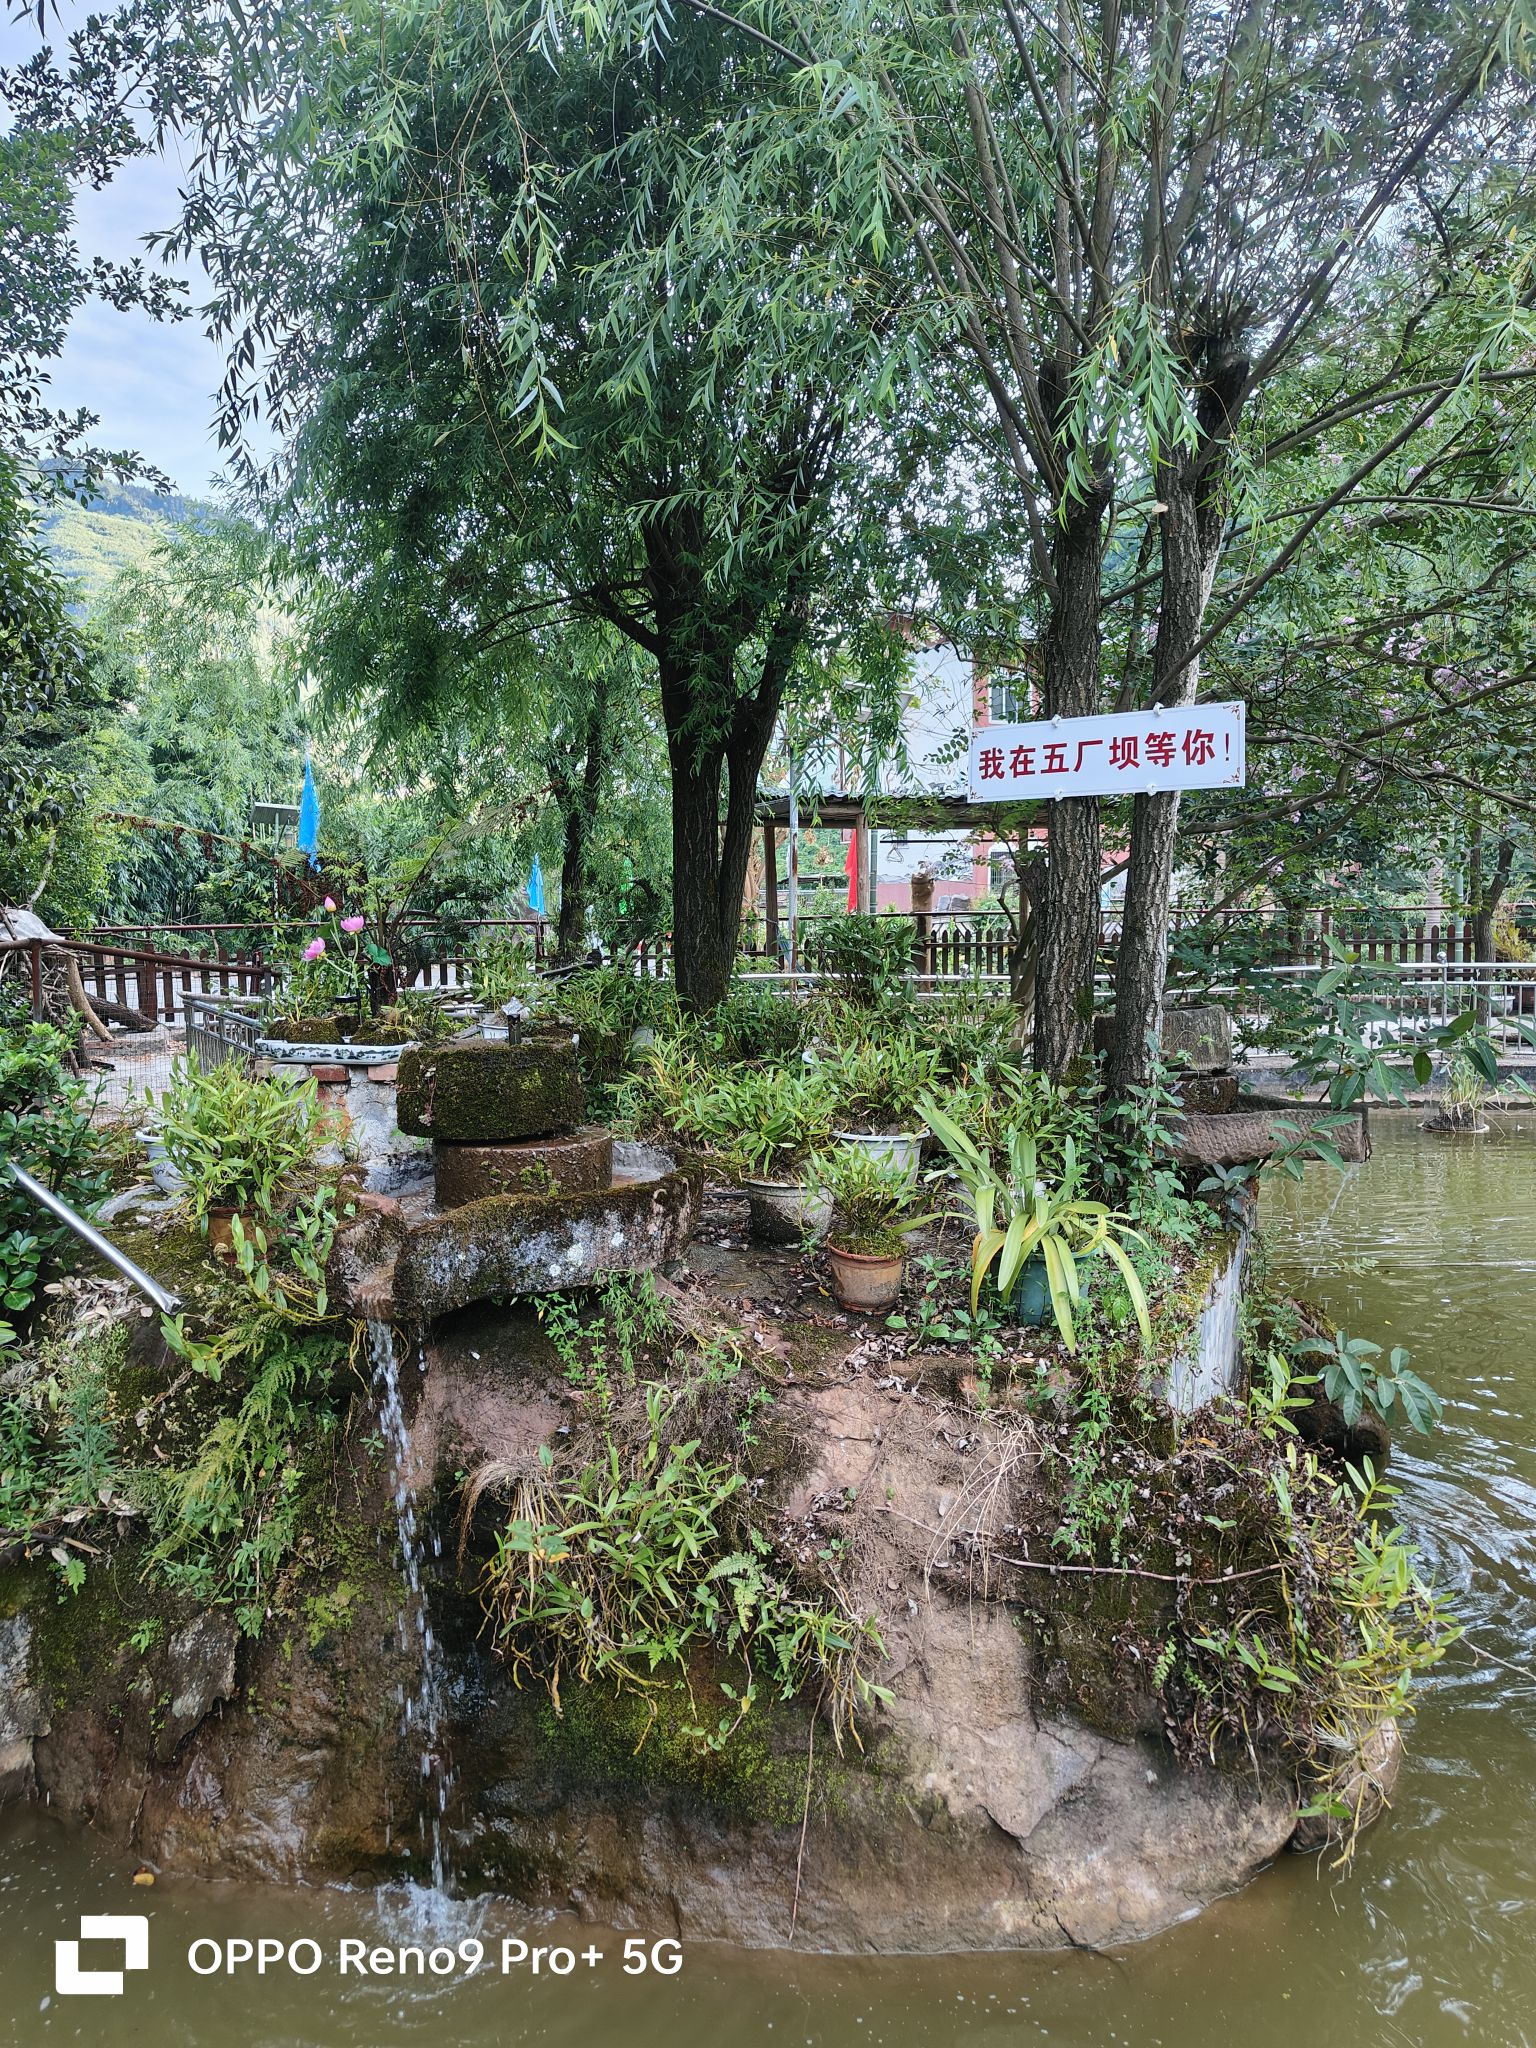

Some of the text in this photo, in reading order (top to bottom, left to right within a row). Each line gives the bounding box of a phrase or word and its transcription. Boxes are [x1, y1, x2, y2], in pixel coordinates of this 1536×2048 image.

[978, 728, 1230, 781] 我在五厂坝等你！
